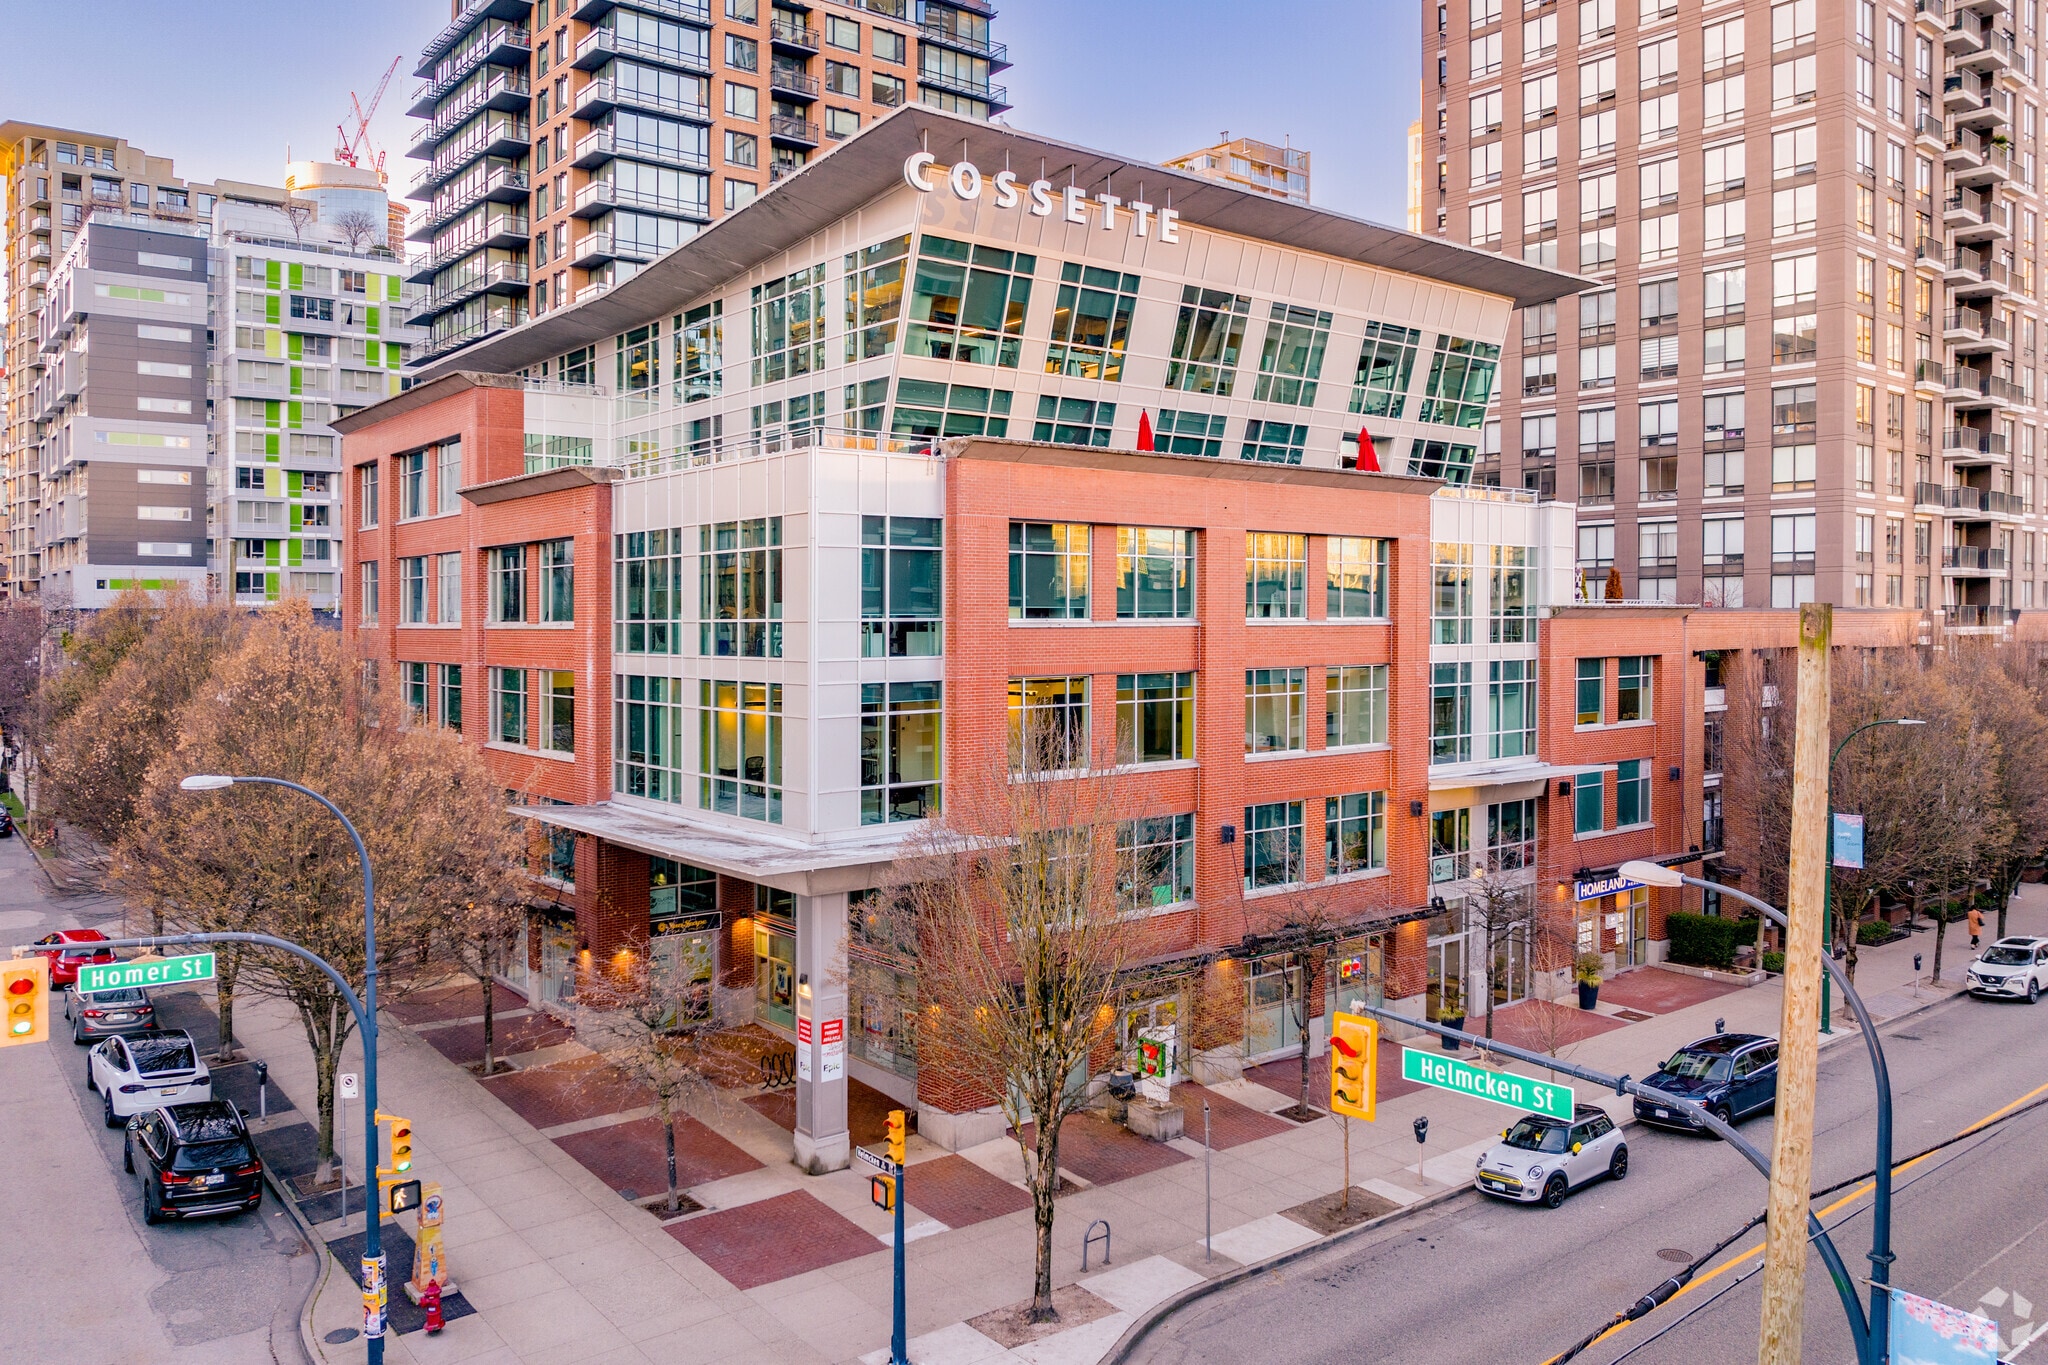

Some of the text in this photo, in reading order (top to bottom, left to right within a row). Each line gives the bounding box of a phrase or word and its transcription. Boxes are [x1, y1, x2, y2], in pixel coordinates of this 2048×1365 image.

[903, 152, 1180, 244] COSSETTE
[1581, 878, 1626, 897] HOMELAND
[91, 959, 203, 987] Homer St
[1421, 1057, 1554, 1111] Helmcken St
